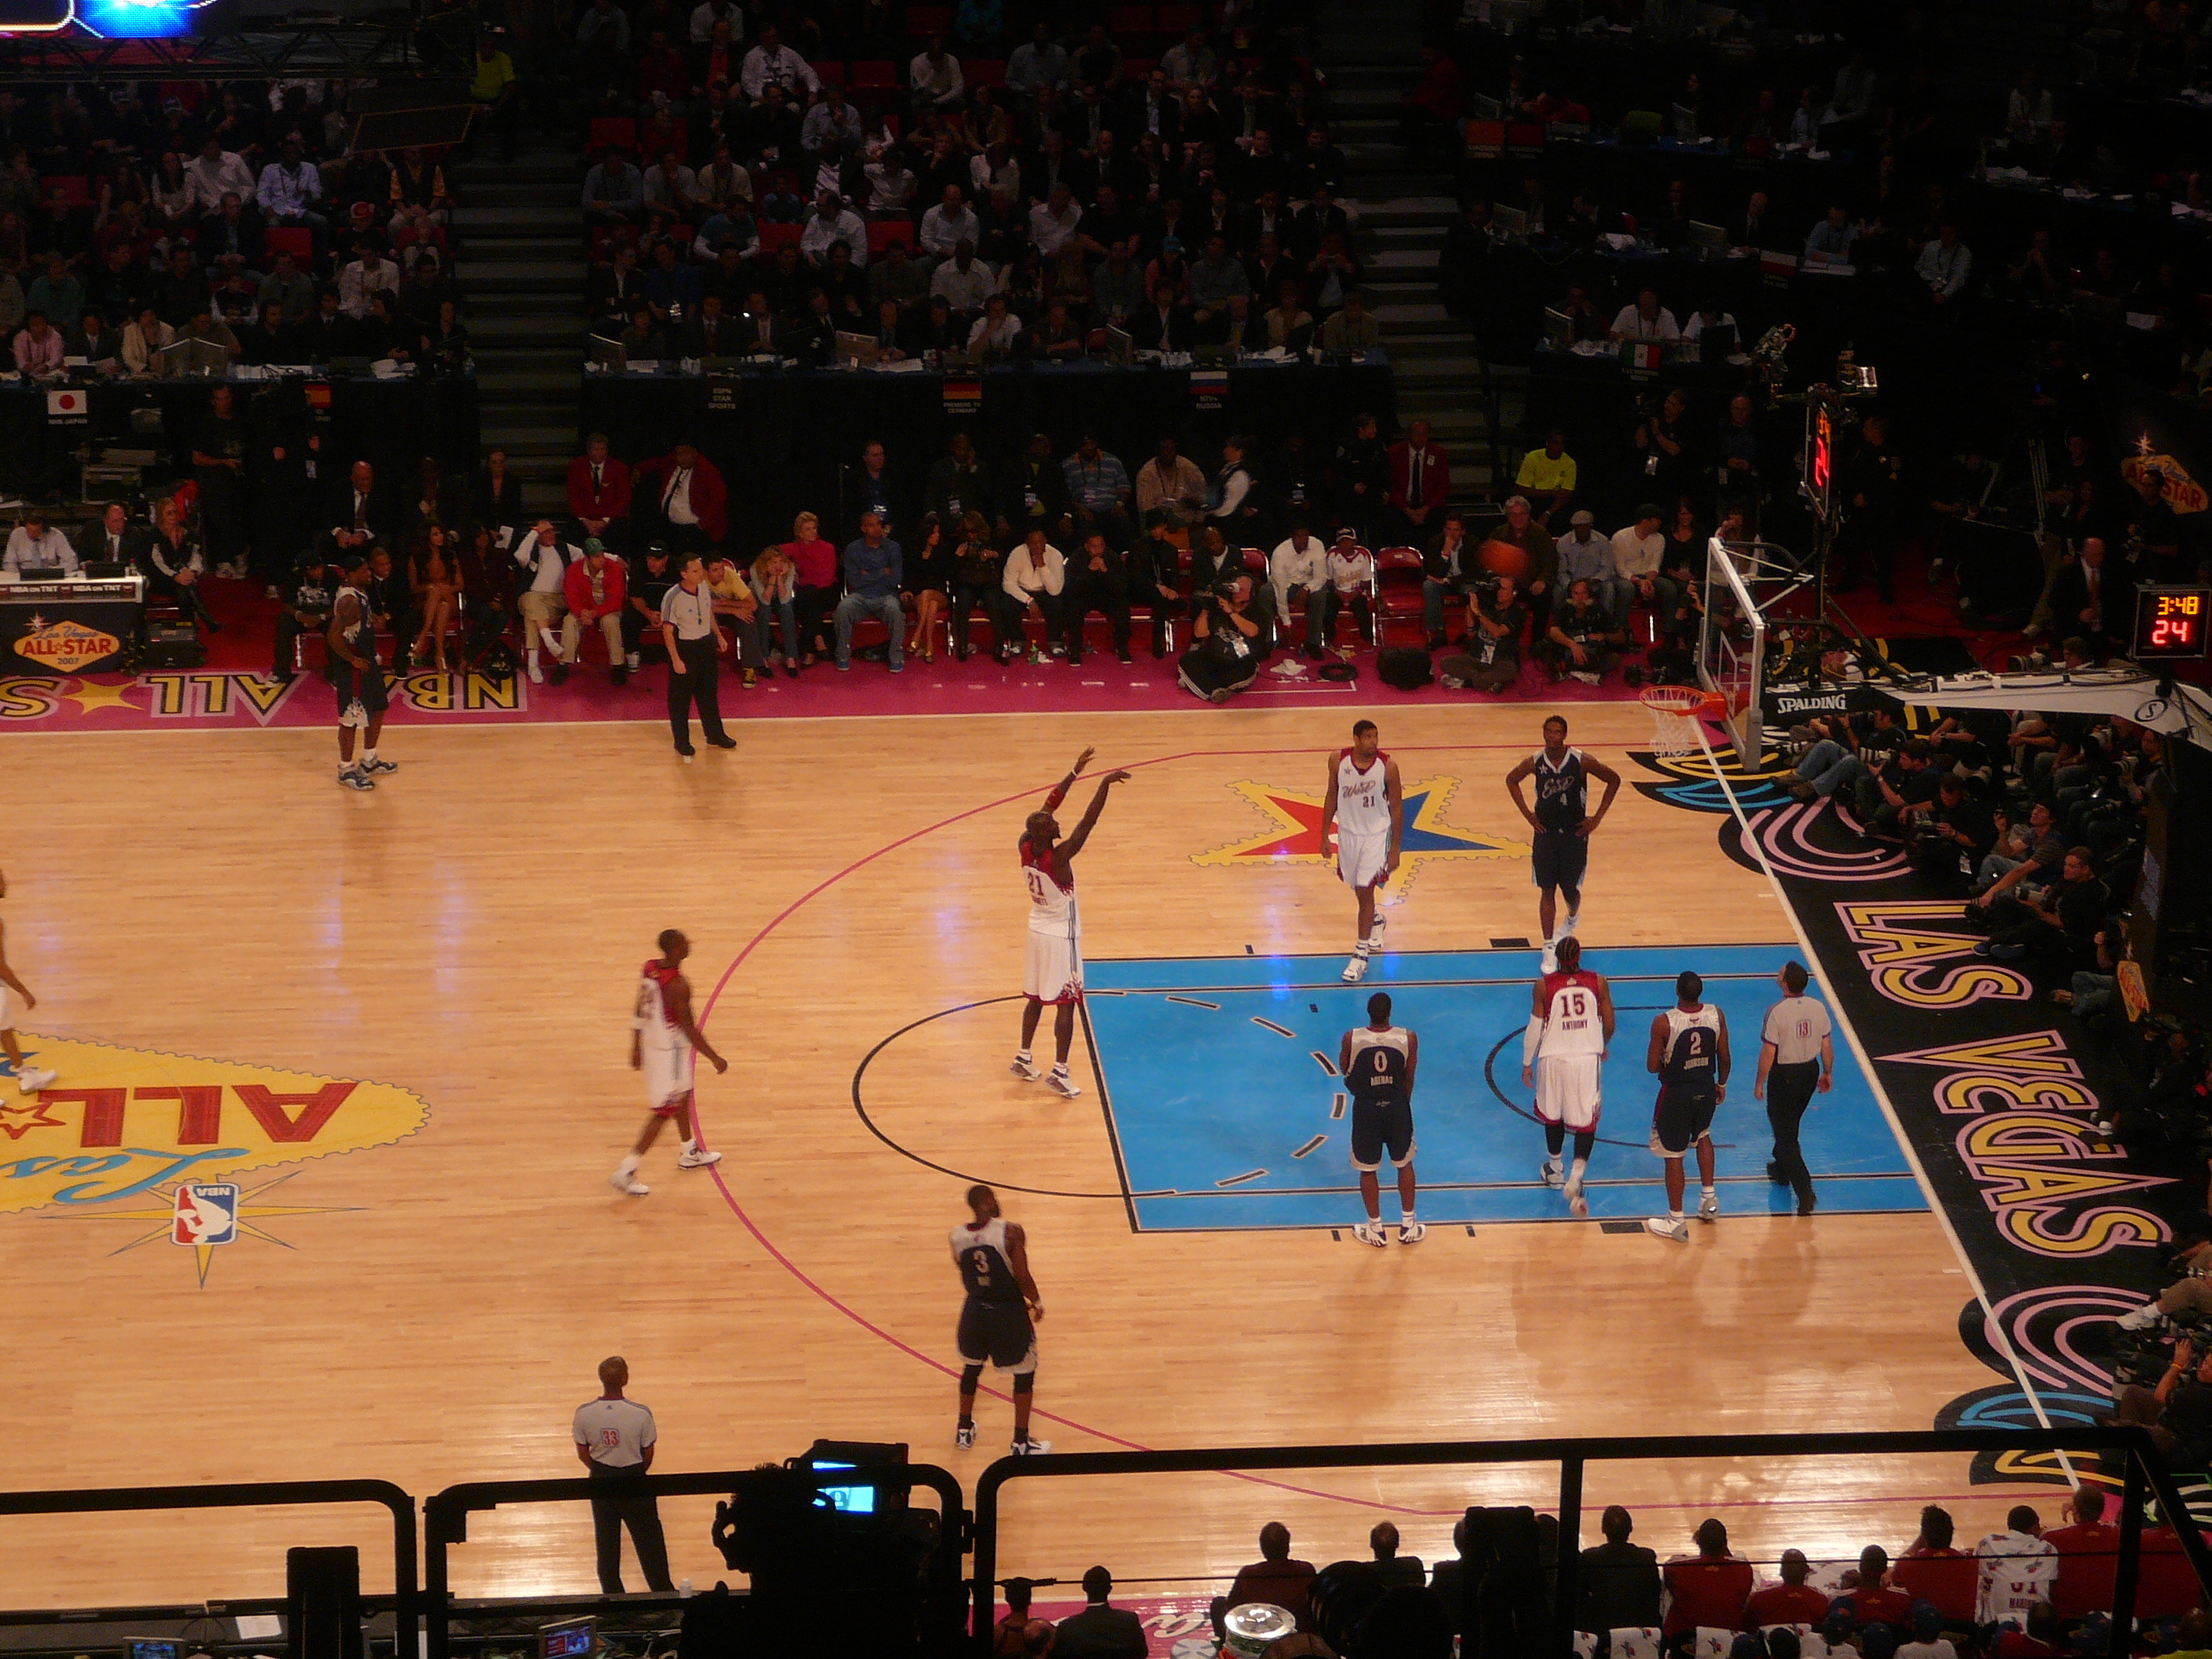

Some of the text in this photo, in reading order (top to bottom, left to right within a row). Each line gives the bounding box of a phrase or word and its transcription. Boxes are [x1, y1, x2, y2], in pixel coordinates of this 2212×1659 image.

[2157, 596, 2199, 616] 3:48
[2151, 619, 2188, 644] 24
[22, 638, 112, 655] ALL STAR
[147, 670, 310, 725] ALL
[1777, 693, 1847, 714] SPALDING
[1362, 796, 1375, 808] 21
[1028, 871, 1044, 897] 21
[1560, 994, 1585, 1017] 15
[1562, 1019, 1588, 1031] ANTHONY
[1798, 1022, 1809, 1037] 13
[1689, 1031, 1701, 1056] 2
[1373, 1051, 1388, 1073] 0
[1833, 900, 2182, 1258] LAS VEGAS
[37, 1082, 360, 1148] ALL
[196, 1185, 230, 1196] NBA
[974, 1250, 991, 1274] 3
[603, 1431, 619, 1446] 33
